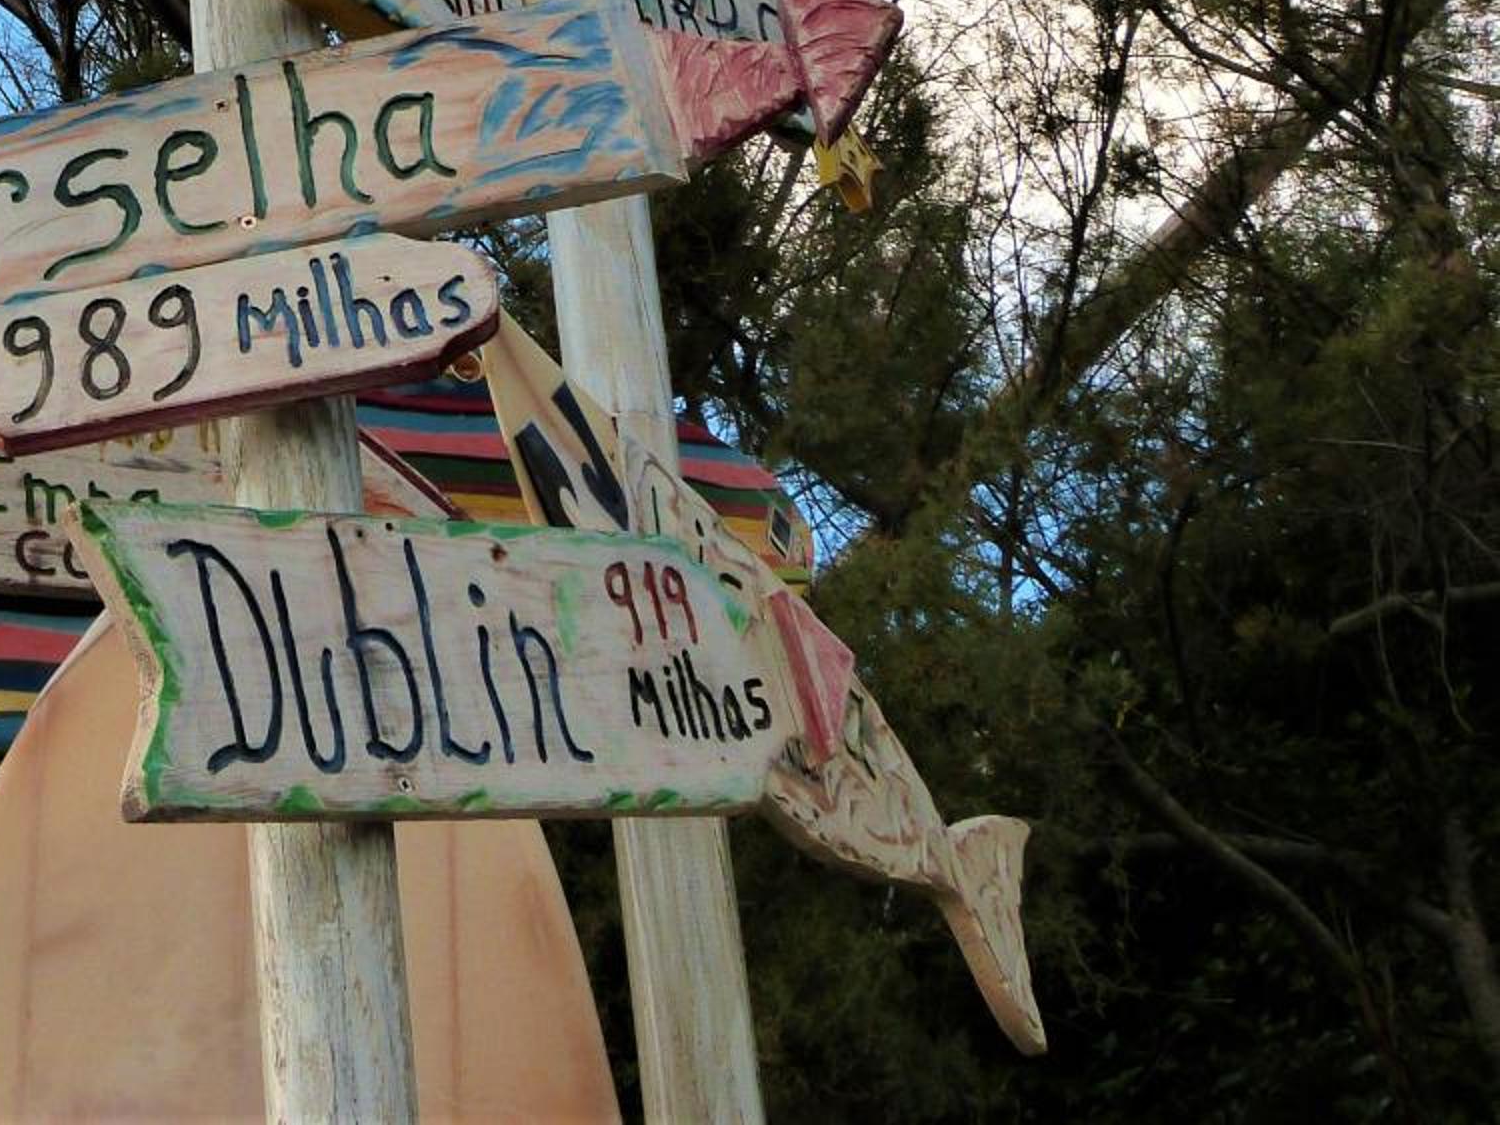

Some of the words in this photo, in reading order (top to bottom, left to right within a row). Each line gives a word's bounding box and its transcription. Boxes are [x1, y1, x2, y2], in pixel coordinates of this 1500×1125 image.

[3, 284, 200, 424] 989
[237, 253, 475, 367] Milhas
[604, 561, 698, 644] 919
[628, 649, 771, 742] Milhas
